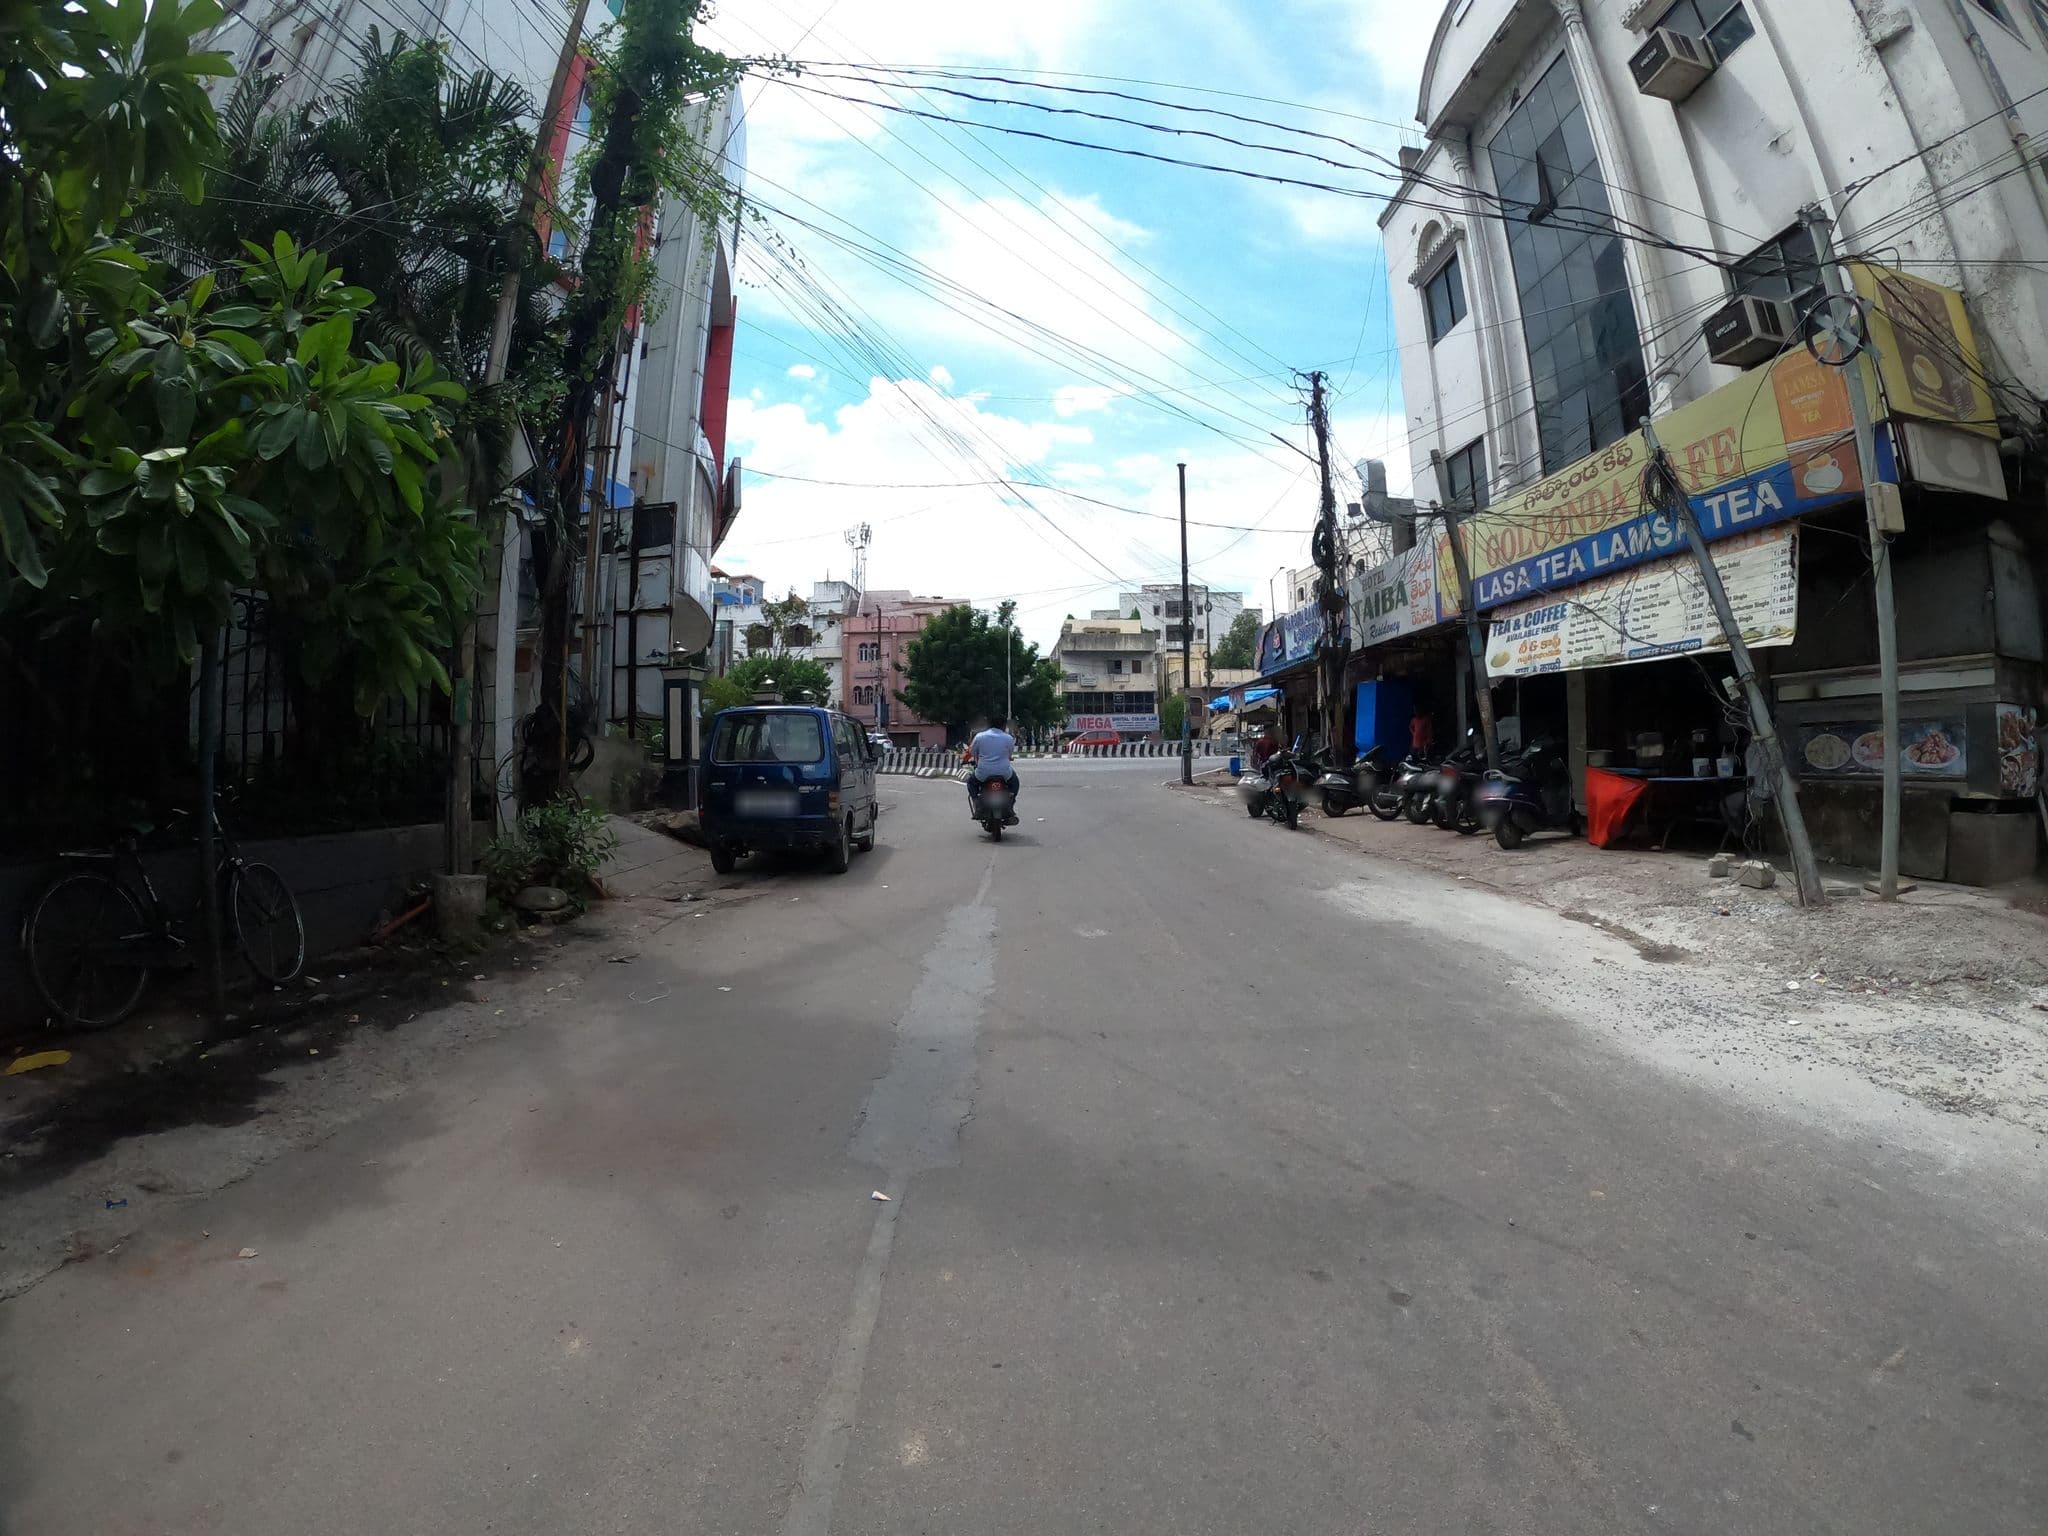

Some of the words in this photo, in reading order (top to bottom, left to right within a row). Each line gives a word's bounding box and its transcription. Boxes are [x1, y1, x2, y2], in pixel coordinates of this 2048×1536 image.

[1486, 479, 1632, 568] GOLCONDA
[1479, 566, 1531, 603] LASA
[1536, 547, 1586, 584] TEA
[1704, 480, 1783, 529] TEA
[1353, 581, 1408, 625] TAIBA
[1492, 619, 1511, 637] TEA
[1513, 619, 1521, 631] &
[1524, 603, 1568, 628] COFFEE
[1370, 620, 1401, 640] Residency
[1506, 627, 1540, 643] AVAILABLE
[1541, 623, 1560, 634] HERE
[1077, 717, 1112, 729] MEGA
